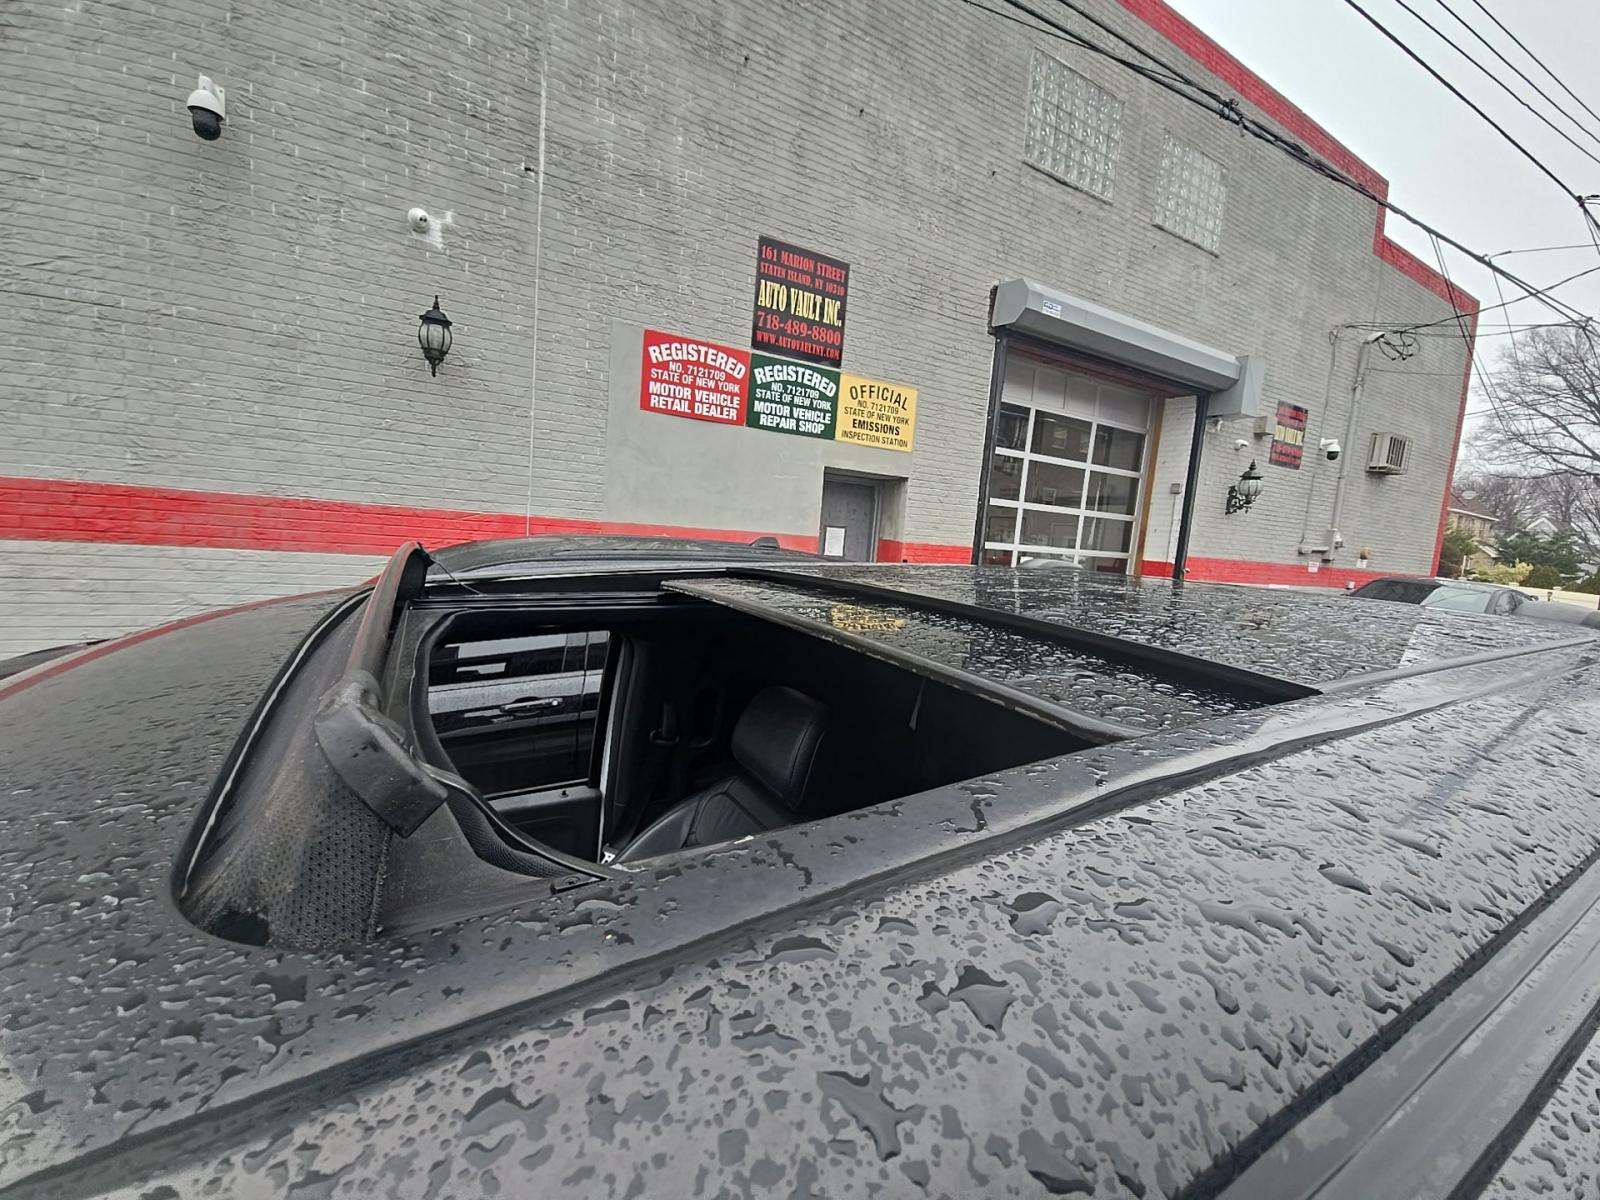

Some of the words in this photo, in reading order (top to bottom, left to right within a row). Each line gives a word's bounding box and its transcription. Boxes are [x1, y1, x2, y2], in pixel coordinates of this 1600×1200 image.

[762, 245, 777, 261] 161
[781, 251, 814, 272] MARION
[817, 262, 846, 282] STREET
[760, 262, 785, 278] STATEN
[788, 270, 812, 288] ISLAND,
[815, 279, 823, 290] NY
[825, 282, 845, 296] 10310
[758, 280, 787, 312] AUTO
[790, 288, 822, 321] VAULT
[822, 297, 842, 327] INC.
[757, 311, 841, 346] 718-489-8800
[756, 331, 840, 360] WWW.AUTOVAULTNY.COM
[648, 342, 746, 380] REGISTERED
[669, 361, 684, 373] NO.
[687, 365, 726, 381] 7121709
[651, 368, 680, 383] STATE
[682, 374, 694, 384] OF
[696, 377, 716, 389] NEW
[718, 381, 740, 394] YORK
[754, 365, 836, 397] REGISTERED
[771, 382, 784, 393] NO.
[787, 385, 820, 399] 7121709
[649, 381, 692, 400] MOTOR
[694, 389, 740, 409] VEHICLE
[650, 395, 692, 413] RETAIL
[694, 402, 737, 421] DEALER
[755, 388, 781, 402] STATE
[782, 394, 792, 403] OF
[793, 395, 811, 407] NEW
[812, 399, 832, 411] YORK
[850, 385, 908, 411] OFFICIAL
[857, 400, 869, 409] NO.
[871, 402, 899, 415] 7121709
[754, 400, 790, 417] MOTOR
[793, 407, 832, 424] VEHICLE
[759, 413, 797, 430] REPAIR
[799, 420, 825, 435] SHOP
[844, 407, 865, 418] STATE
[867, 411, 875, 419] OF
[877, 413, 891, 423] NEW
[893, 416, 910, 426] YORK
[841, 430, 881, 443] INSPECTION
[881, 437, 908, 448] STATION
[852, 418, 900, 436] EMISSIONS
